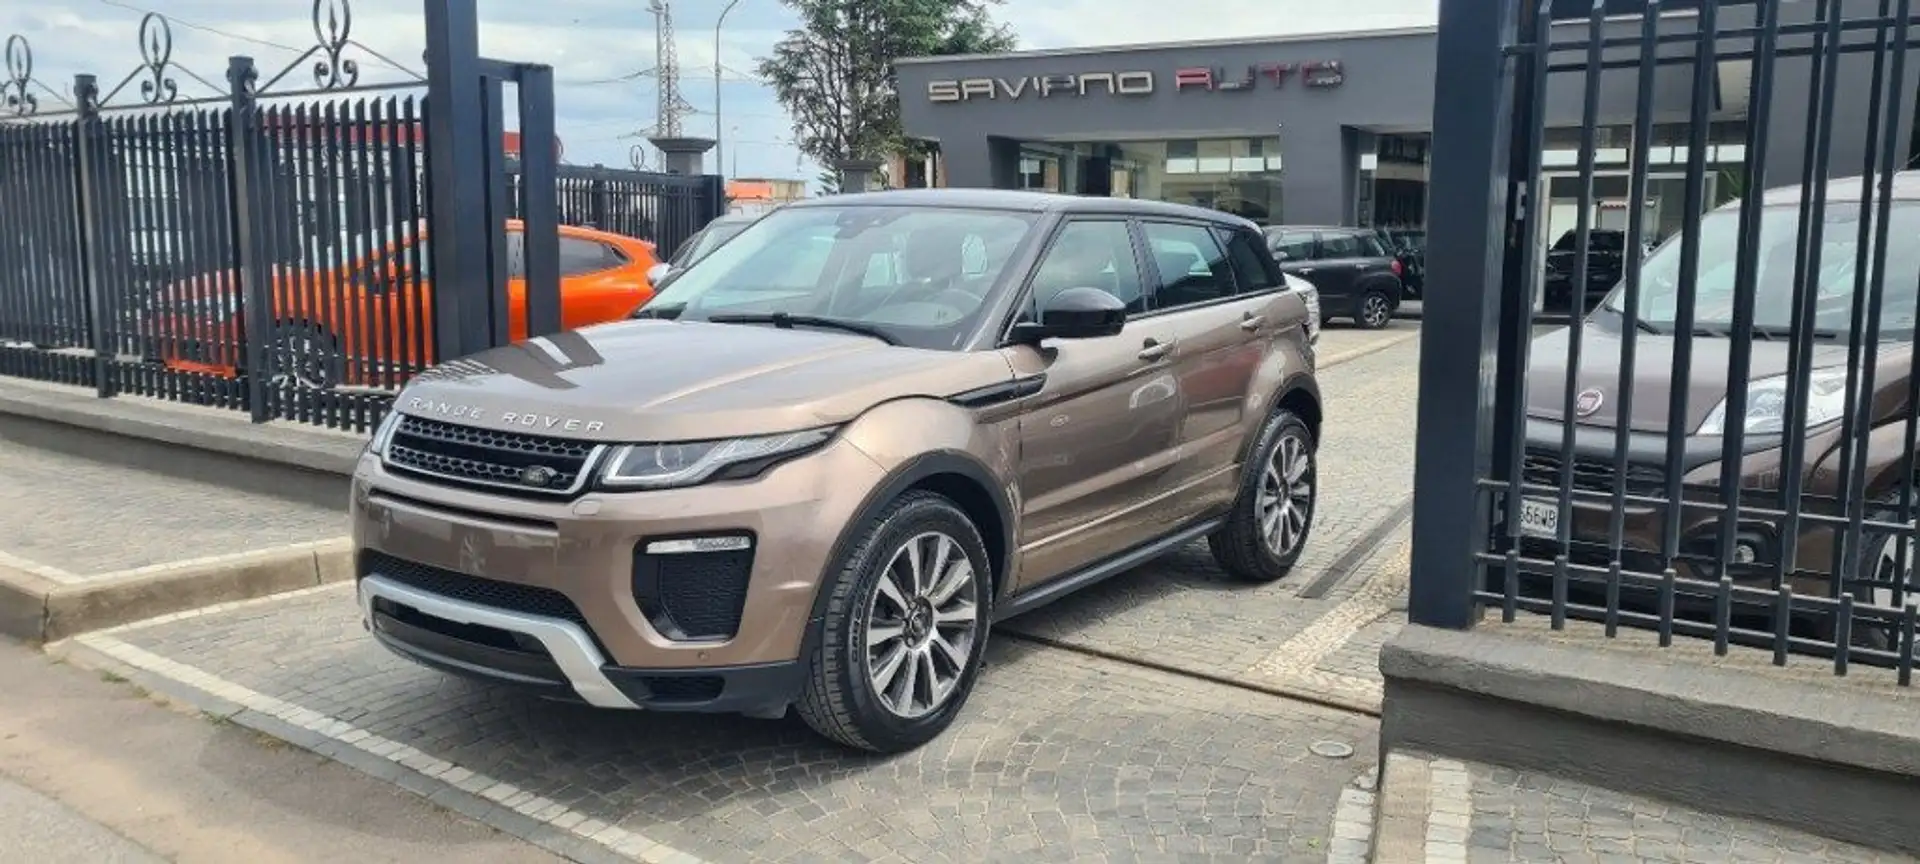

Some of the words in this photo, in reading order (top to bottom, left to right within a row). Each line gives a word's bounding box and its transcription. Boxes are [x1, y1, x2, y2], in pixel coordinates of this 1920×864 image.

[927, 71, 1153, 102] SAVIANO
[1175, 60, 1344, 92] AUTO
[408, 396, 484, 419] RANGE
[502, 411, 604, 432] ROVER
